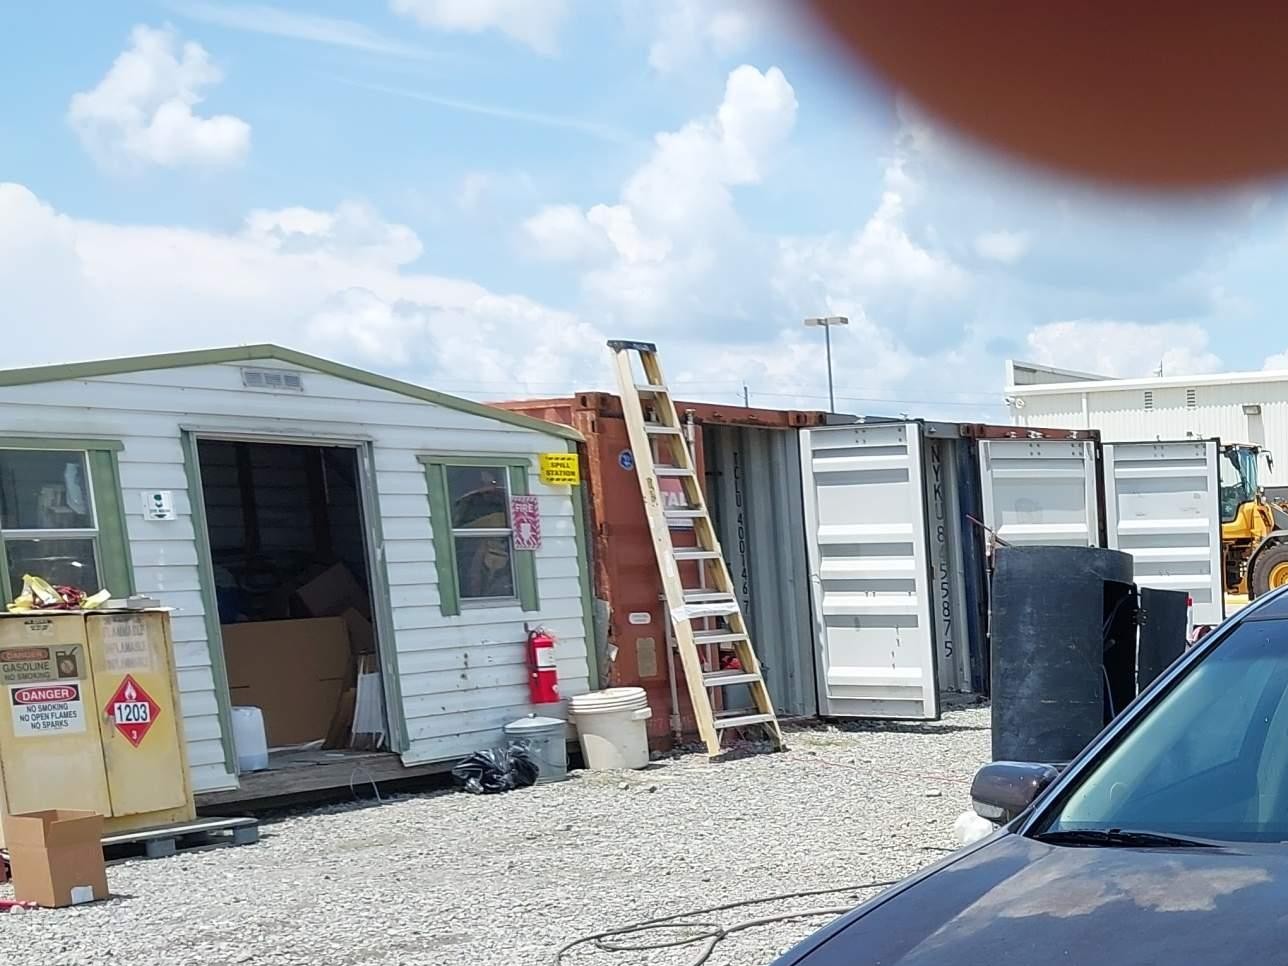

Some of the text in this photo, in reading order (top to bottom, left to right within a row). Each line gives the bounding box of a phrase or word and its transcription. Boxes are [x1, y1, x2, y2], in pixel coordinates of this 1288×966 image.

[2, 661, 50, 673] GASOLINE
[22, 688, 70, 701] DANGER
[26, 703, 69, 713] NO SMOKING
[116, 703, 148, 722] 1203
[19, 710, 77, 722] NO OPEN FLAMES
[31, 720, 69, 730] NO SPARKS
[131, 730, 138, 740] 3
